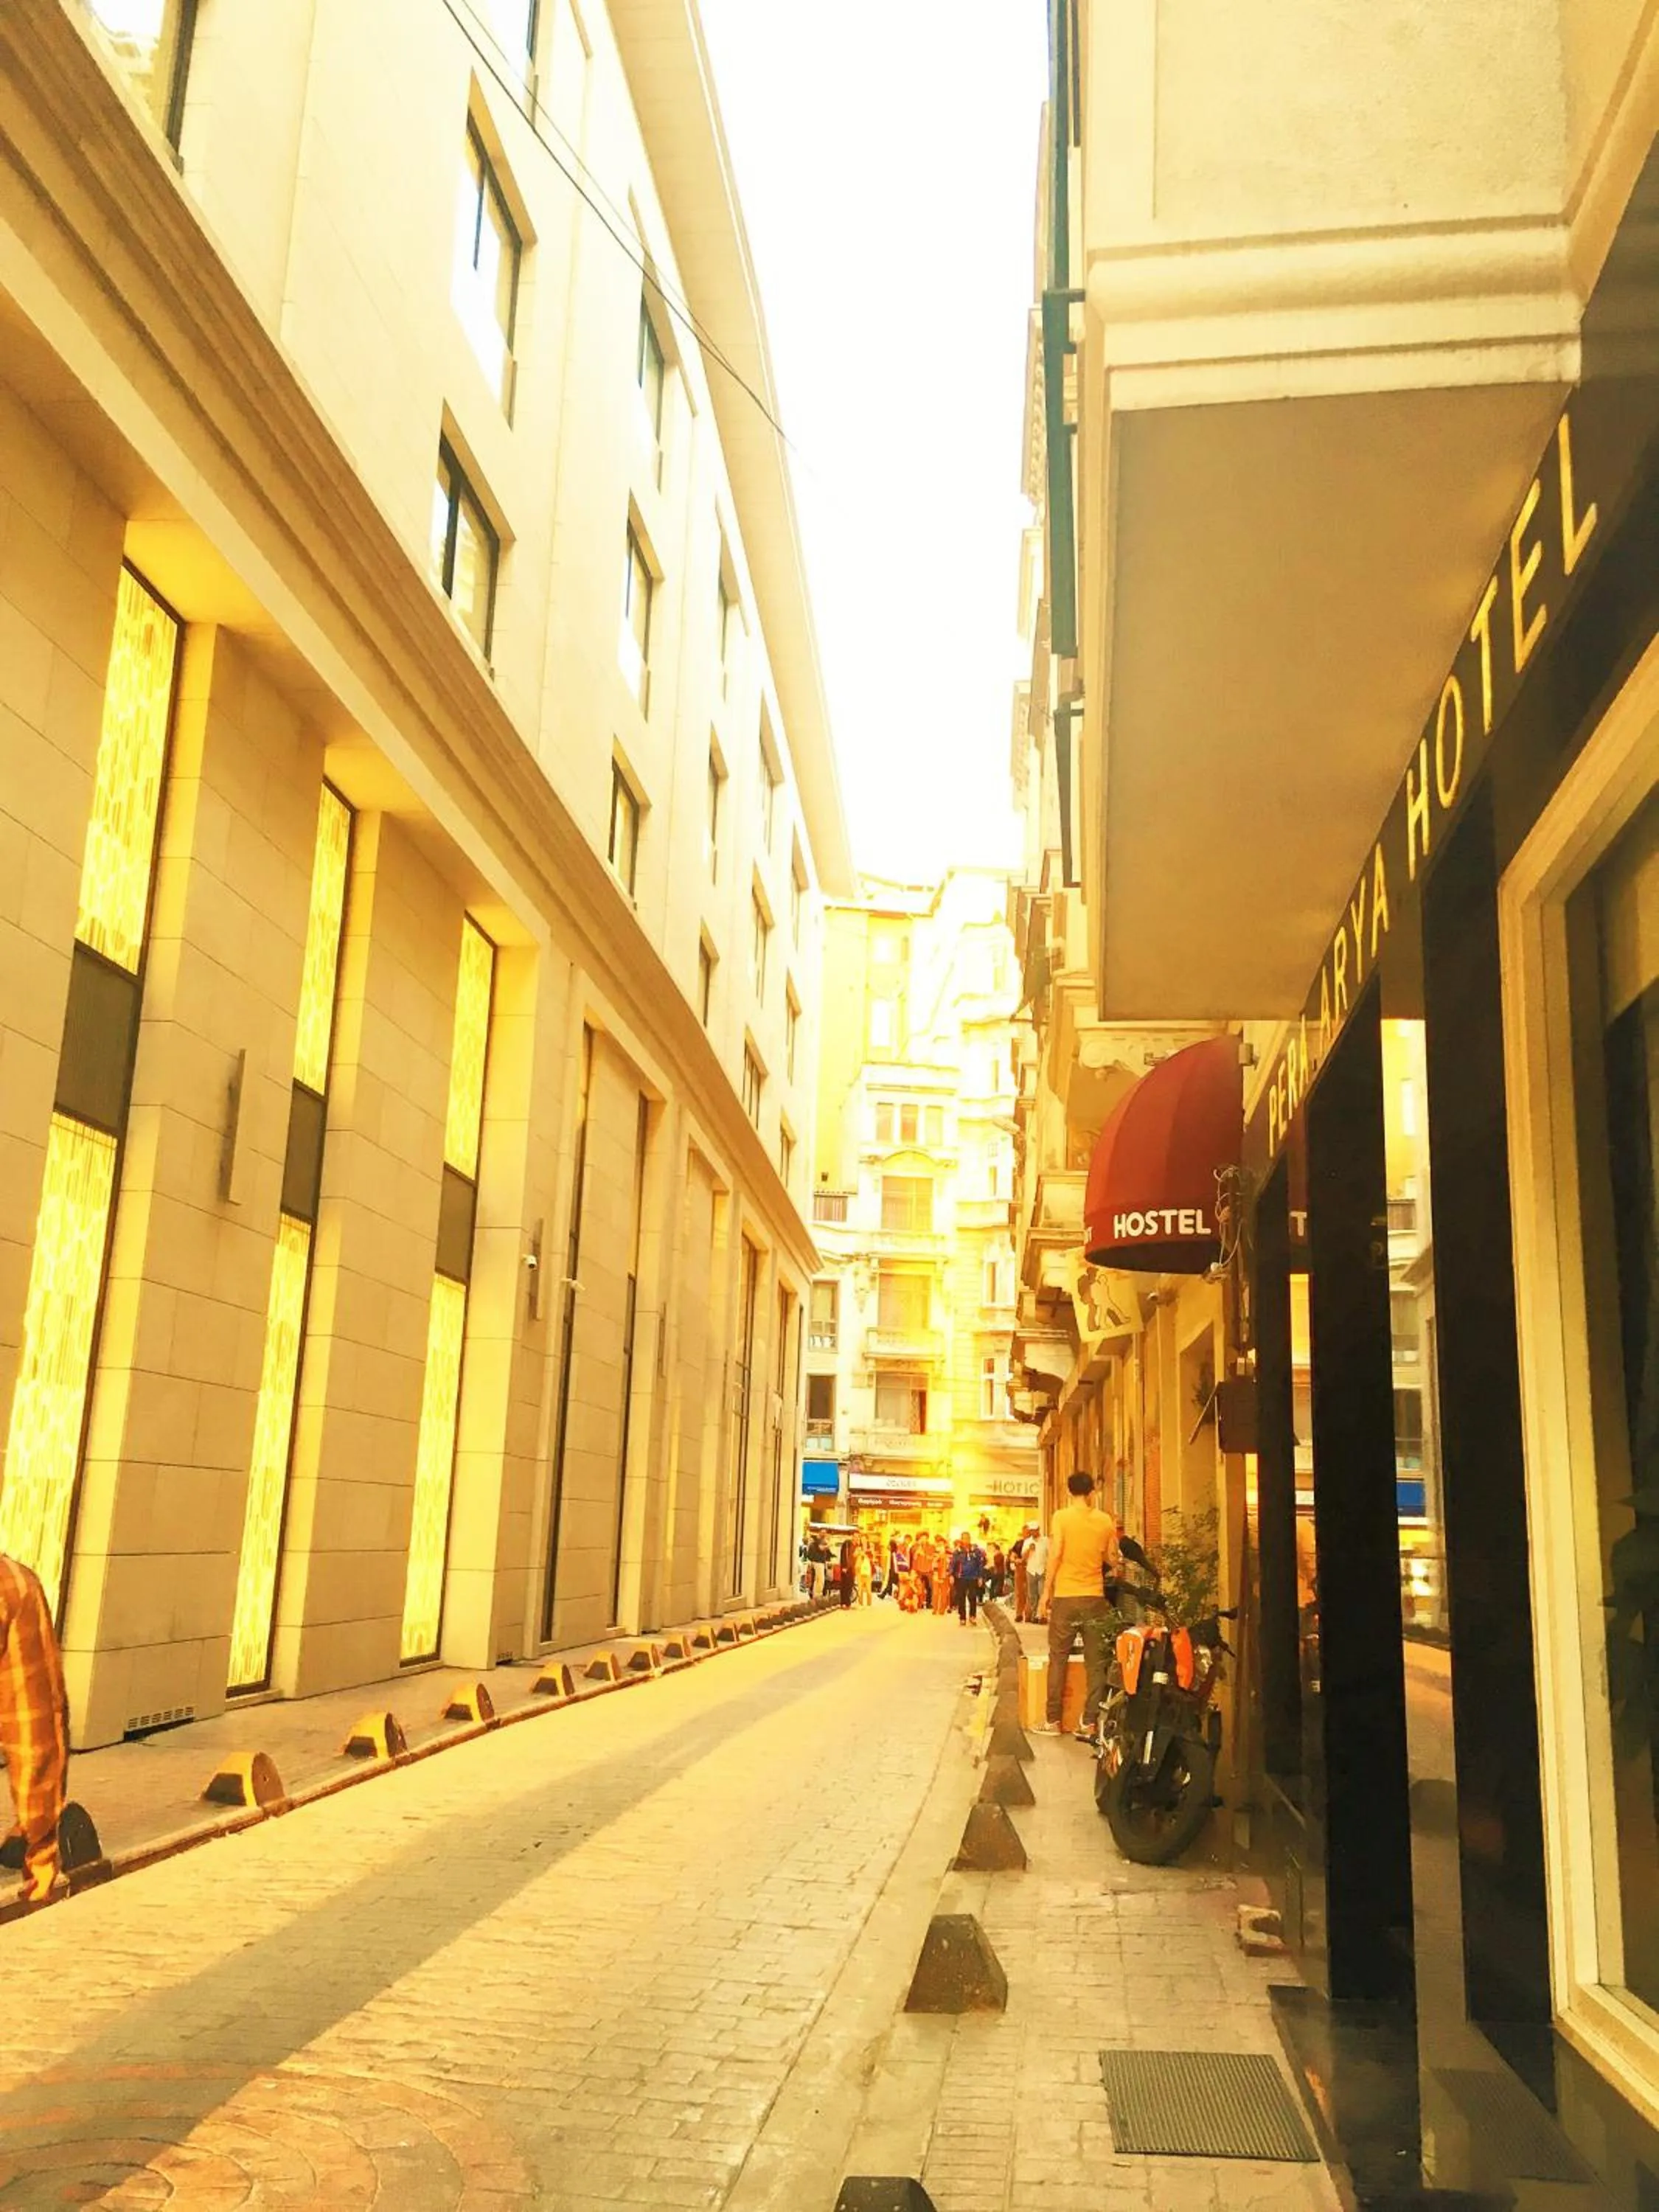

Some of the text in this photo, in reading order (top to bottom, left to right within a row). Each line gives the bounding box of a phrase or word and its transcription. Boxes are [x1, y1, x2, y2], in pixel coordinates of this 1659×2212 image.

[1268, 413, 1597, 1158] PERA ARYA HOTEL
[1113, 1208, 1211, 1239] HOSTEL
